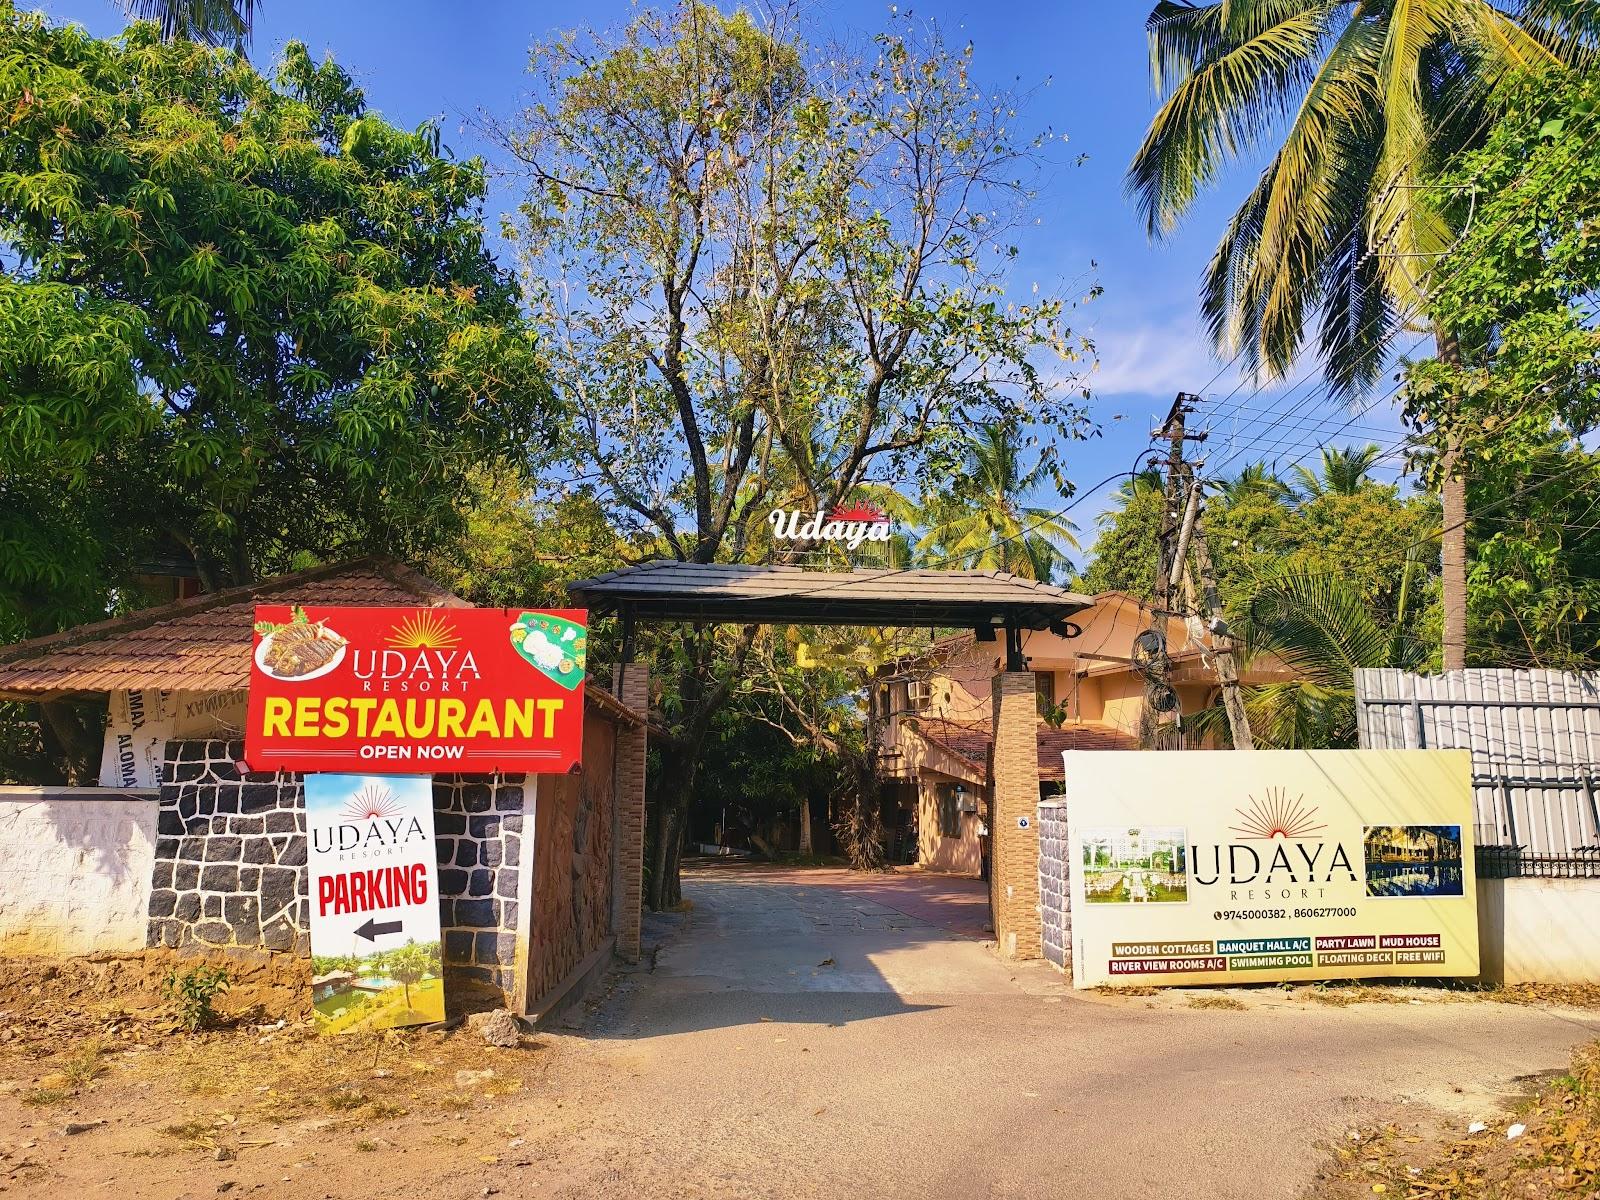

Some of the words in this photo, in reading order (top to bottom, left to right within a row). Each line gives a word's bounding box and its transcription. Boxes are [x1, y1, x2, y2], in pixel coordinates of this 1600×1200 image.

[769, 509, 892, 550] Udaya
[352, 650, 481, 680] UDAYA
[364, 680, 468, 692] RESORT
[263, 697, 564, 738] RESTAURANT
[360, 745, 411, 759] OPEN
[418, 745, 464, 759] NOW
[314, 816, 426, 853] UDAYA
[340, 846, 404, 861] RESORT
[1192, 842, 1358, 885] UDAYA
[319, 863, 428, 916] PARKING
[1231, 888, 1324, 900] RESORT
[1224, 910, 1286, 920] 9745000382
[1294, 908, 1356, 918] 8606277000
[1219, 942, 1264, 953] BANQUET
[1266, 940, 1291, 950] HALL
[1293, 940, 1308, 951] A/C
[1316, 939, 1346, 949] PARTY
[1348, 938, 1374, 948] LAWN
[1382, 938, 1404, 947] MUD
[1406, 936, 1439, 946] HOUSE
[1115, 945, 1159, 955] WOODEN
[1162, 944, 1210, 954] COTTAGES
[1397, 952, 1421, 961] FREE
[1423, 951, 1444, 961] WIFI
[1112, 961, 1141, 971] RIVER
[1142, 960, 1168, 971] VIEW
[1170, 959, 1205, 970] ROOMS
[1207, 958, 1223, 970] A/C
[1285, 956, 1311, 965] POOL
[1319, 954, 1364, 964] FLOATING
[1366, 953, 1391, 962] DECK
